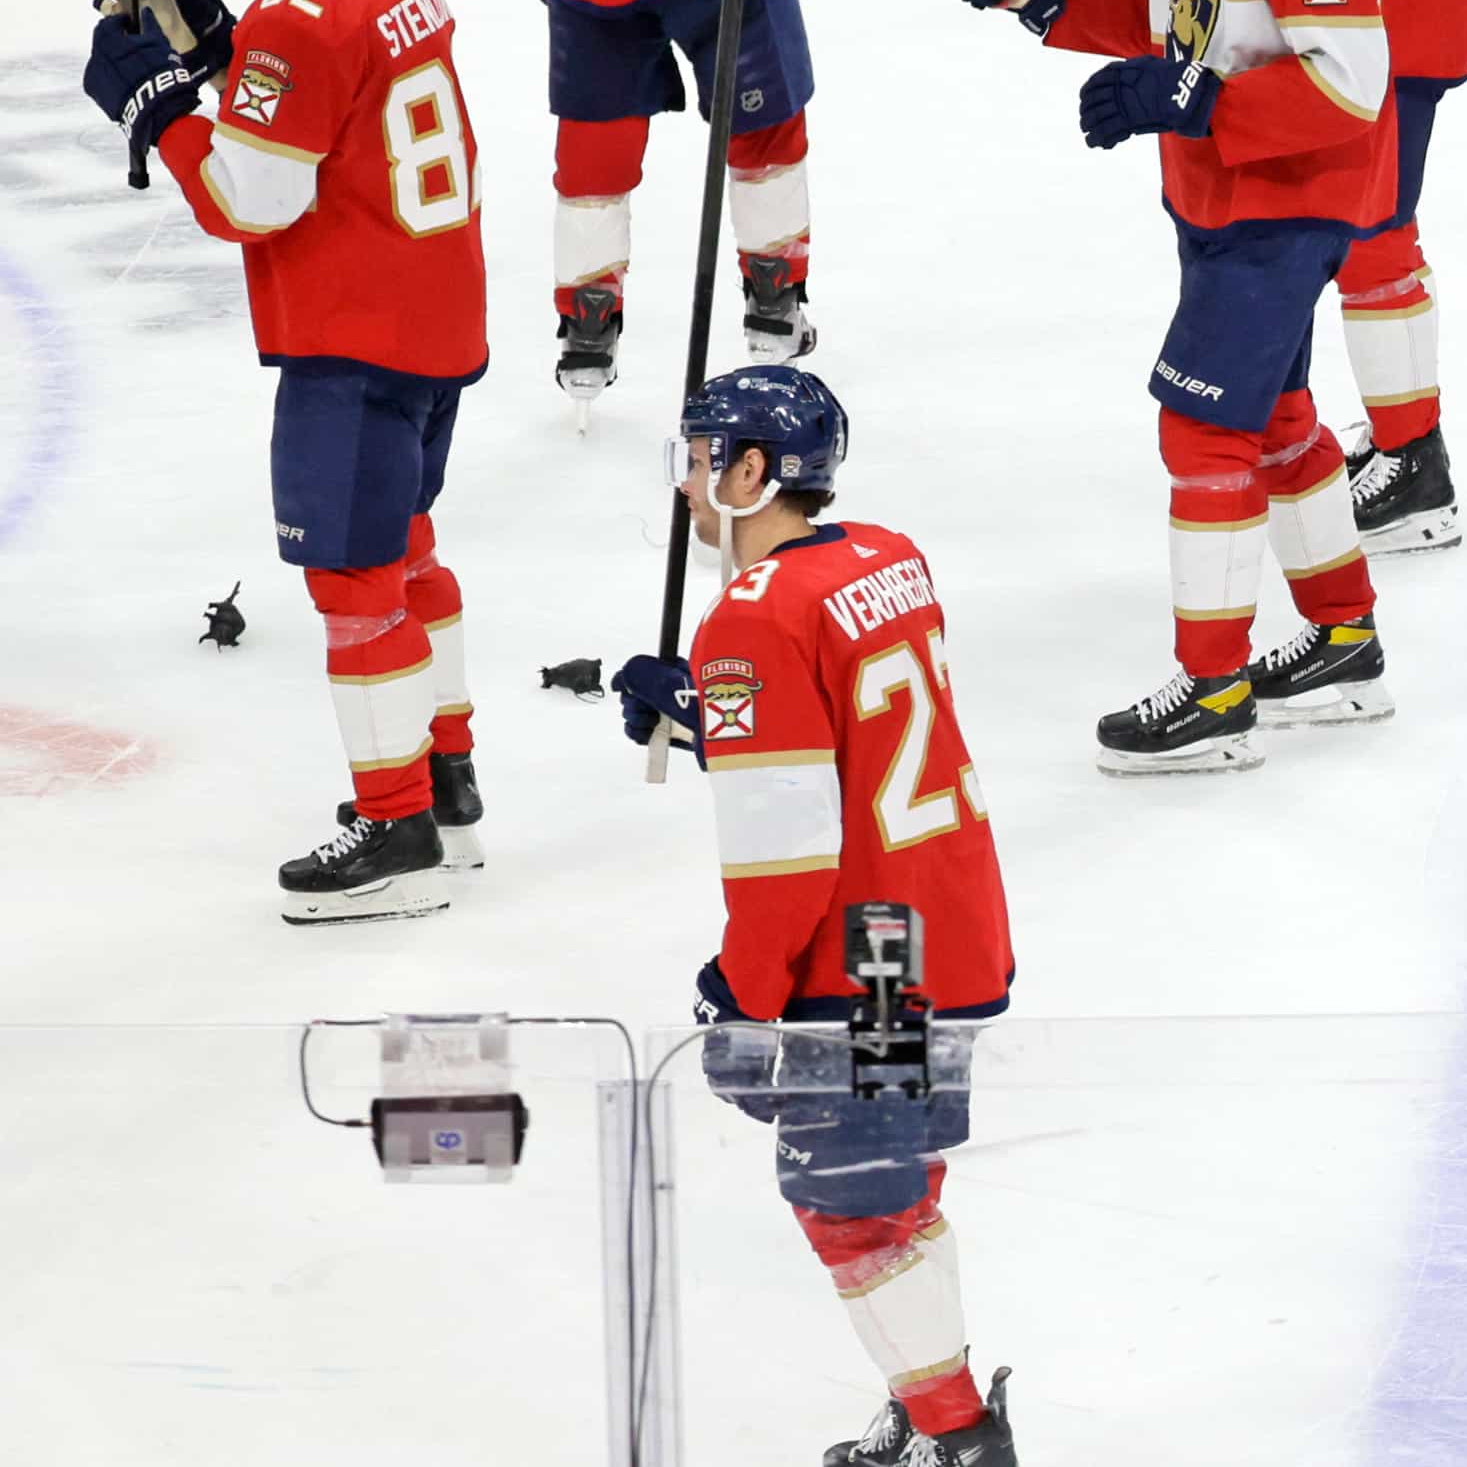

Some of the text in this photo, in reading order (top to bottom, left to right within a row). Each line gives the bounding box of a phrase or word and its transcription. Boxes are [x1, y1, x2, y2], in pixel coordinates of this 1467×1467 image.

[381, 56, 482, 240] 8
[1155, 360, 1224, 402] BAUER
[706, 660, 750, 676] FLORIDA
